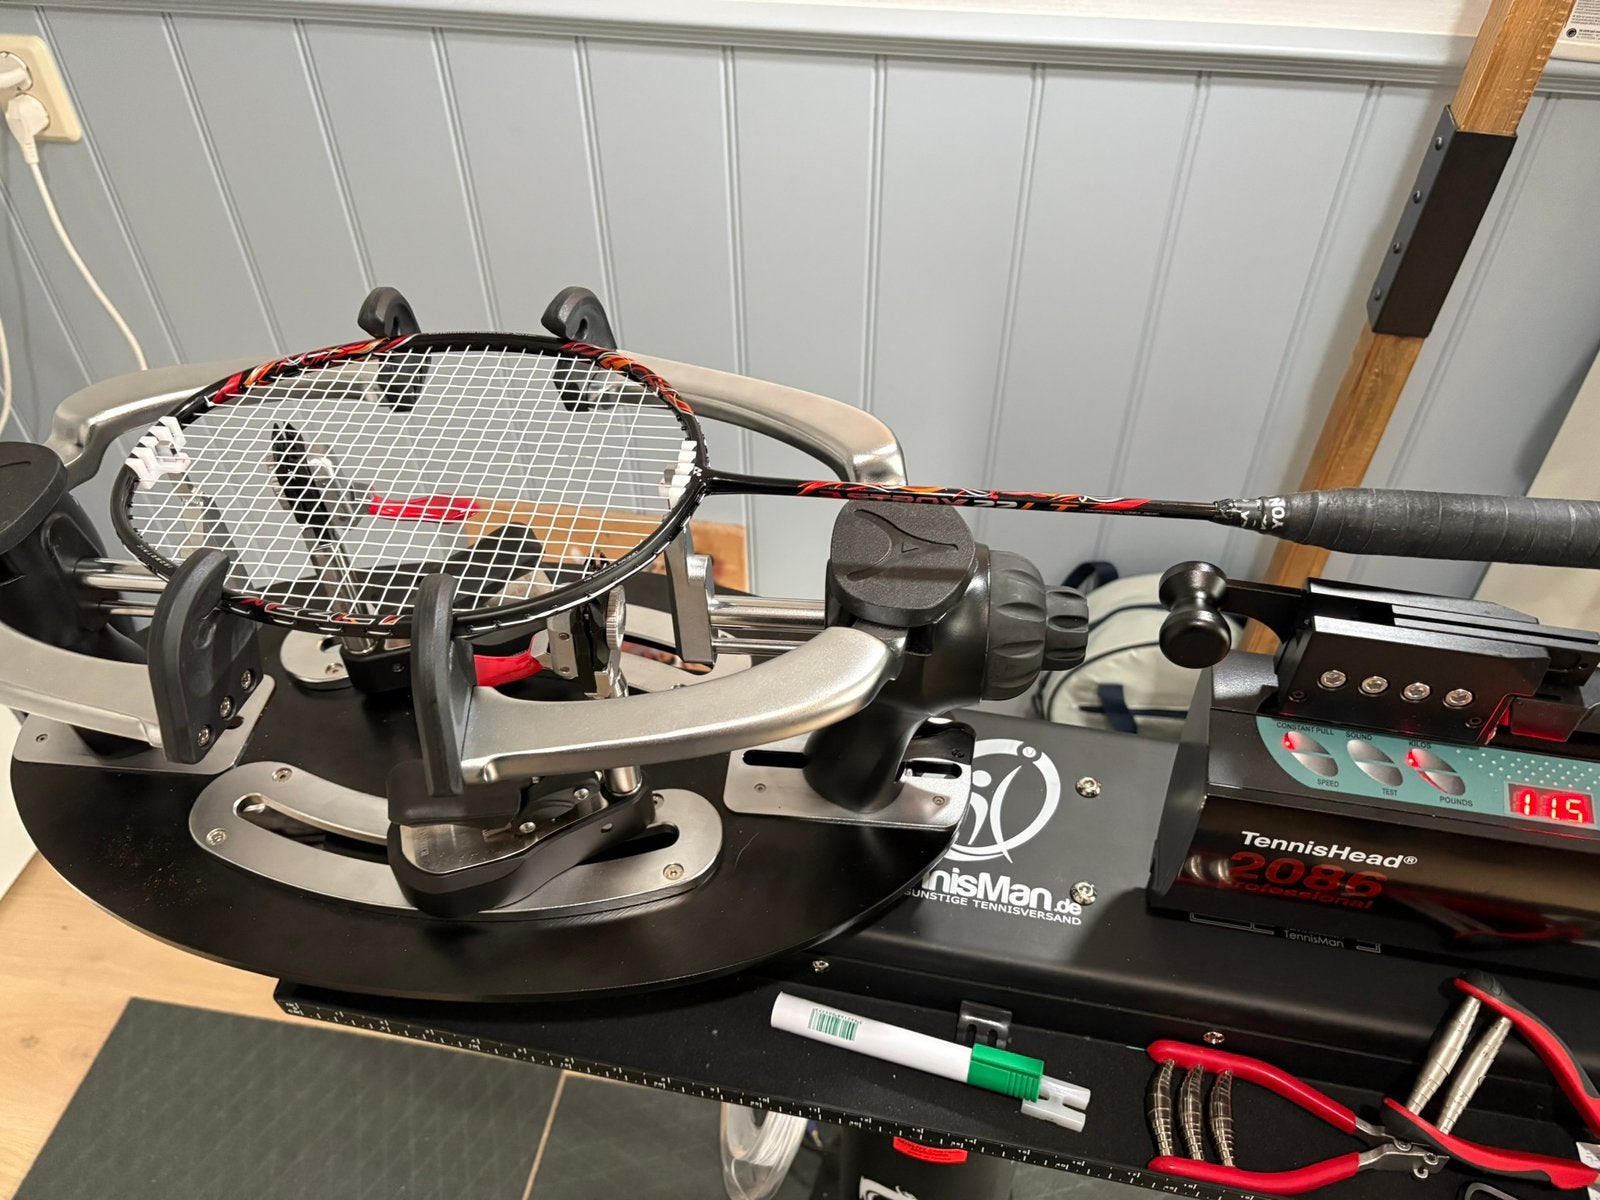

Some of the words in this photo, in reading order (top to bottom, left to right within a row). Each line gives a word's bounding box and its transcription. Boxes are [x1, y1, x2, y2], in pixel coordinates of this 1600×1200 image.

[1276, 721, 1315, 734] CONSTANT
[1316, 727, 1335, 736] PULL
[1345, 731, 1373, 741] SOUND
[1408, 740, 1432, 750] KILOS
[1316, 777, 1340, 788] SPEED
[1381, 787, 1398, 797] TEST
[1439, 795, 1474, 807] POUNDS
[1229, 850, 1389, 898] 2086
[972, 899, 1082, 926] TENNISVERSAND
[1283, 929, 1345, 948] TennisMan
